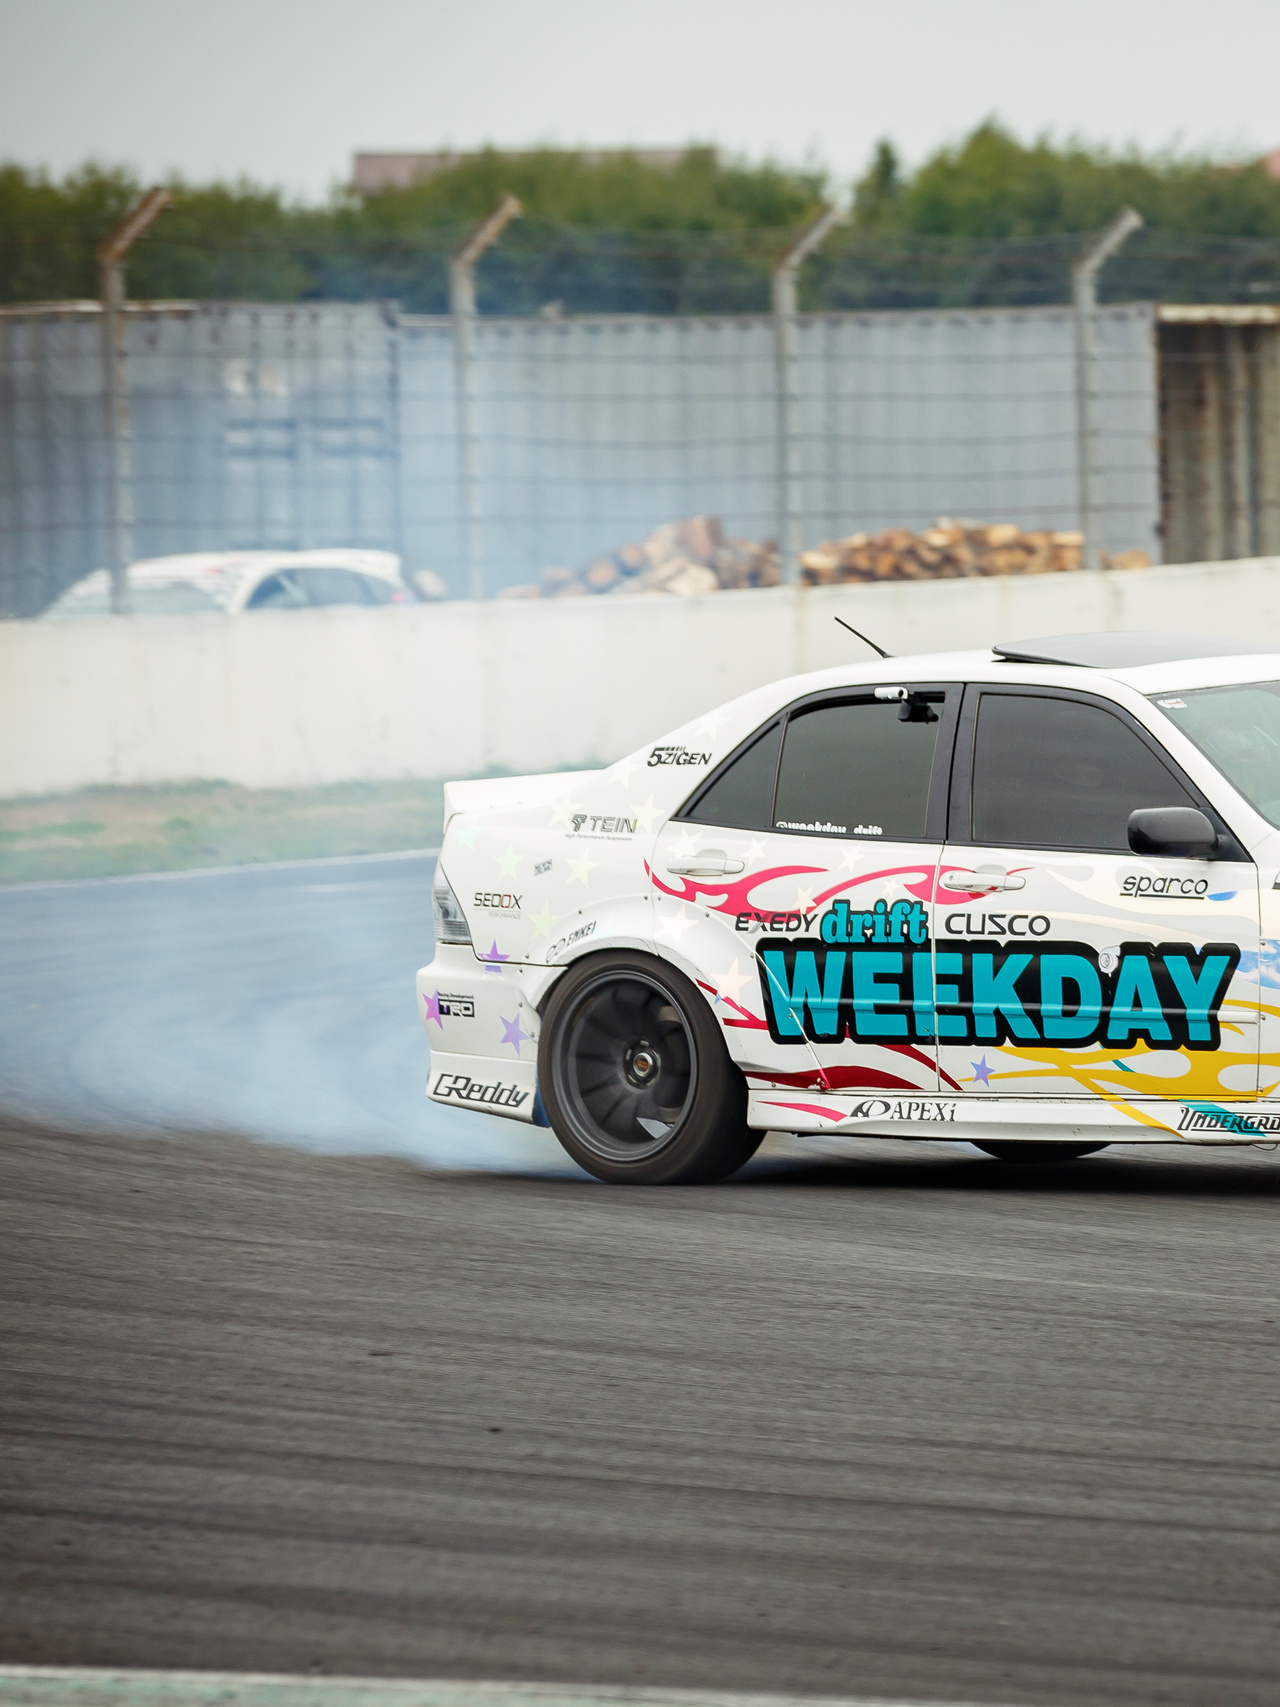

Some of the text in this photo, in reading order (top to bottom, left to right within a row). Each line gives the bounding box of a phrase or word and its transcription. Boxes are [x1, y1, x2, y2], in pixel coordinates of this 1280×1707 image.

[647, 746, 712, 767] 5ZIGEN
[589, 815, 638, 833] TEIN
[1121, 875, 1209, 899] sparco
[473, 892, 522, 909] SEDOX
[735, 912, 819, 934] EXEDY
[820, 899, 928, 944] drift
[945, 913, 1051, 936] CUSCO
[759, 946, 1234, 1044] WEEKDAY
[438, 1000, 475, 1017] TRD
[432, 1073, 530, 1108] GReddy
